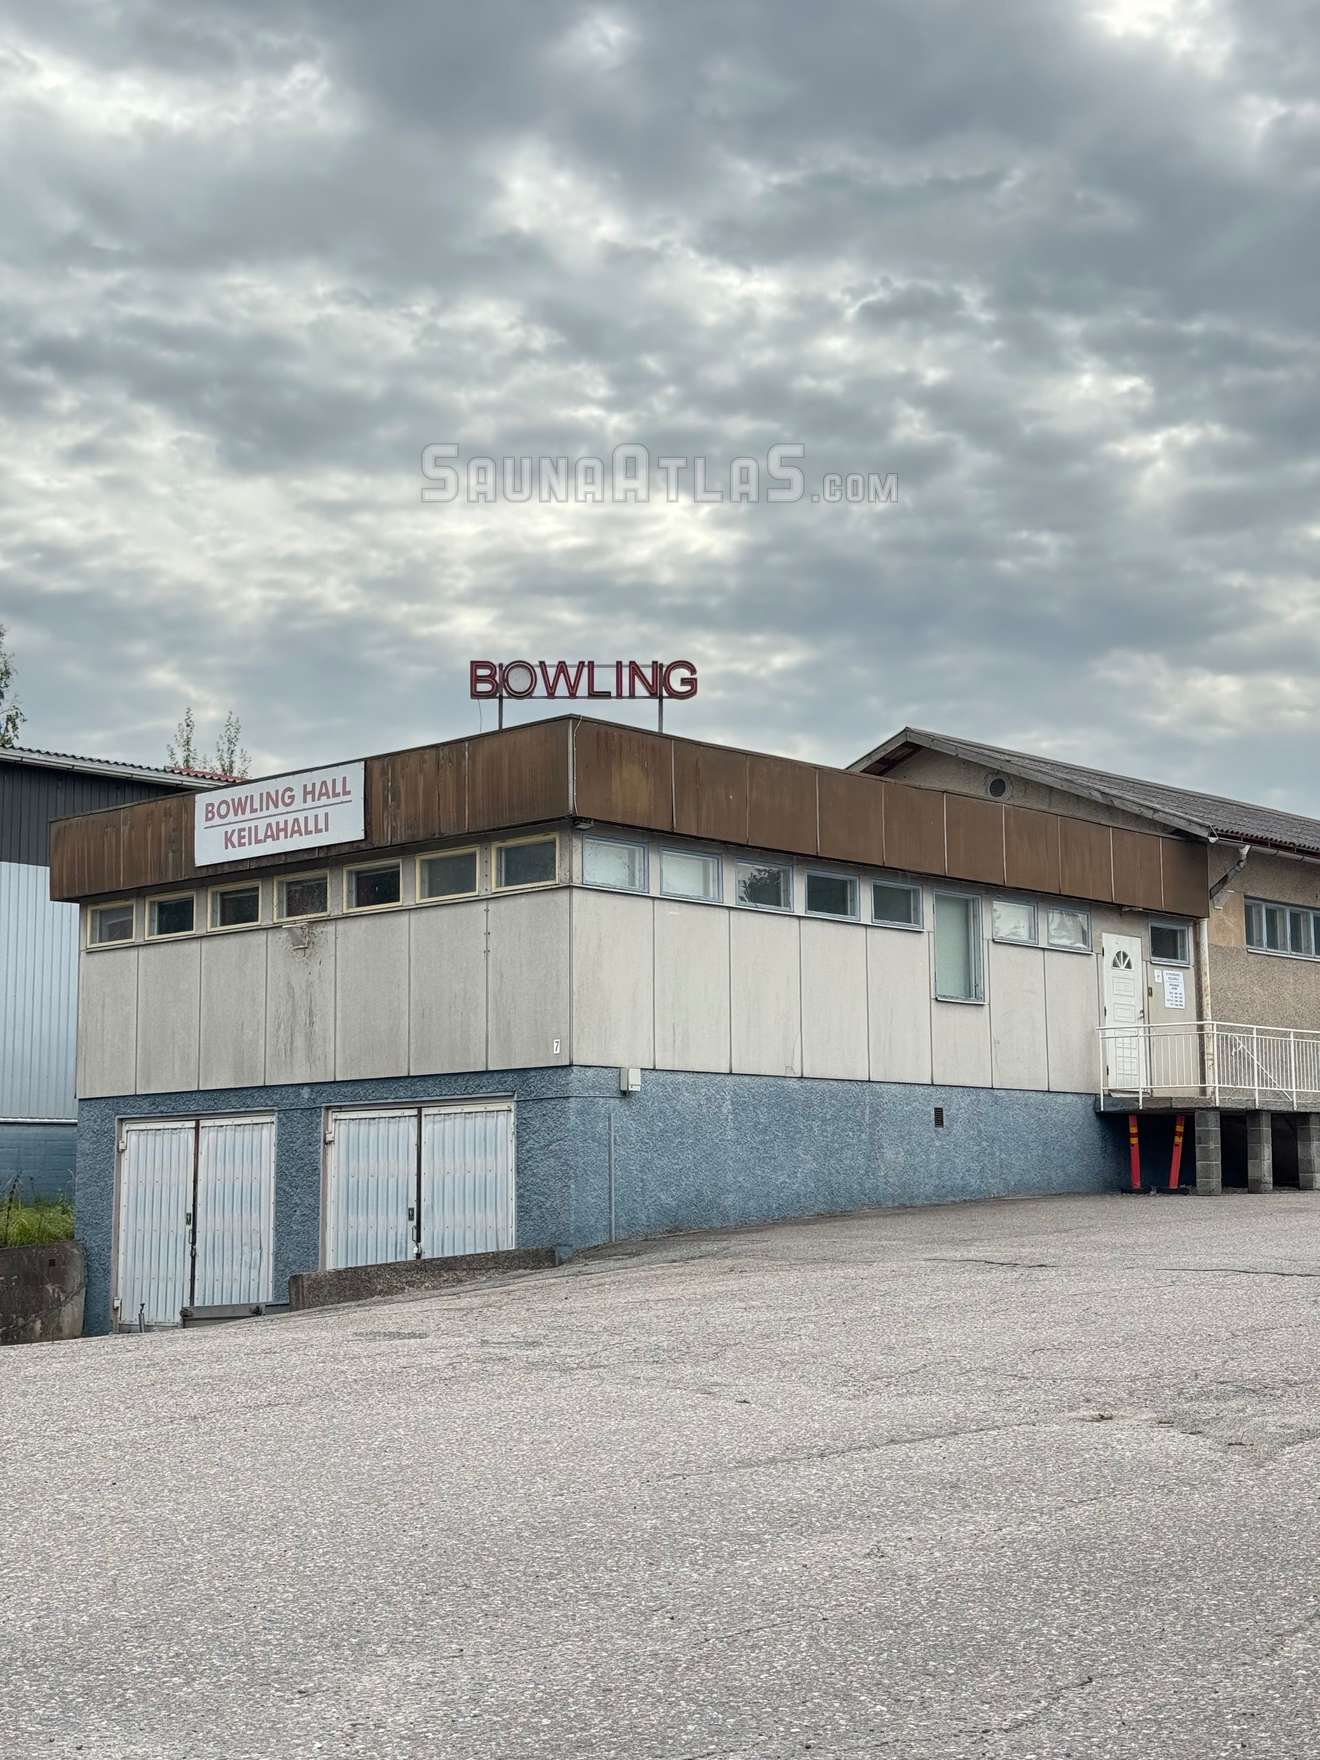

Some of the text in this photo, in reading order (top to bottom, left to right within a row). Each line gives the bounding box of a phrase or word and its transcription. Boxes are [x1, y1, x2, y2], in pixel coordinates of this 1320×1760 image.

[469, 660, 698, 700] BOWLING
[204, 776, 352, 823] BOWLING HALL
[223, 811, 329, 850] KEILAHALLI
